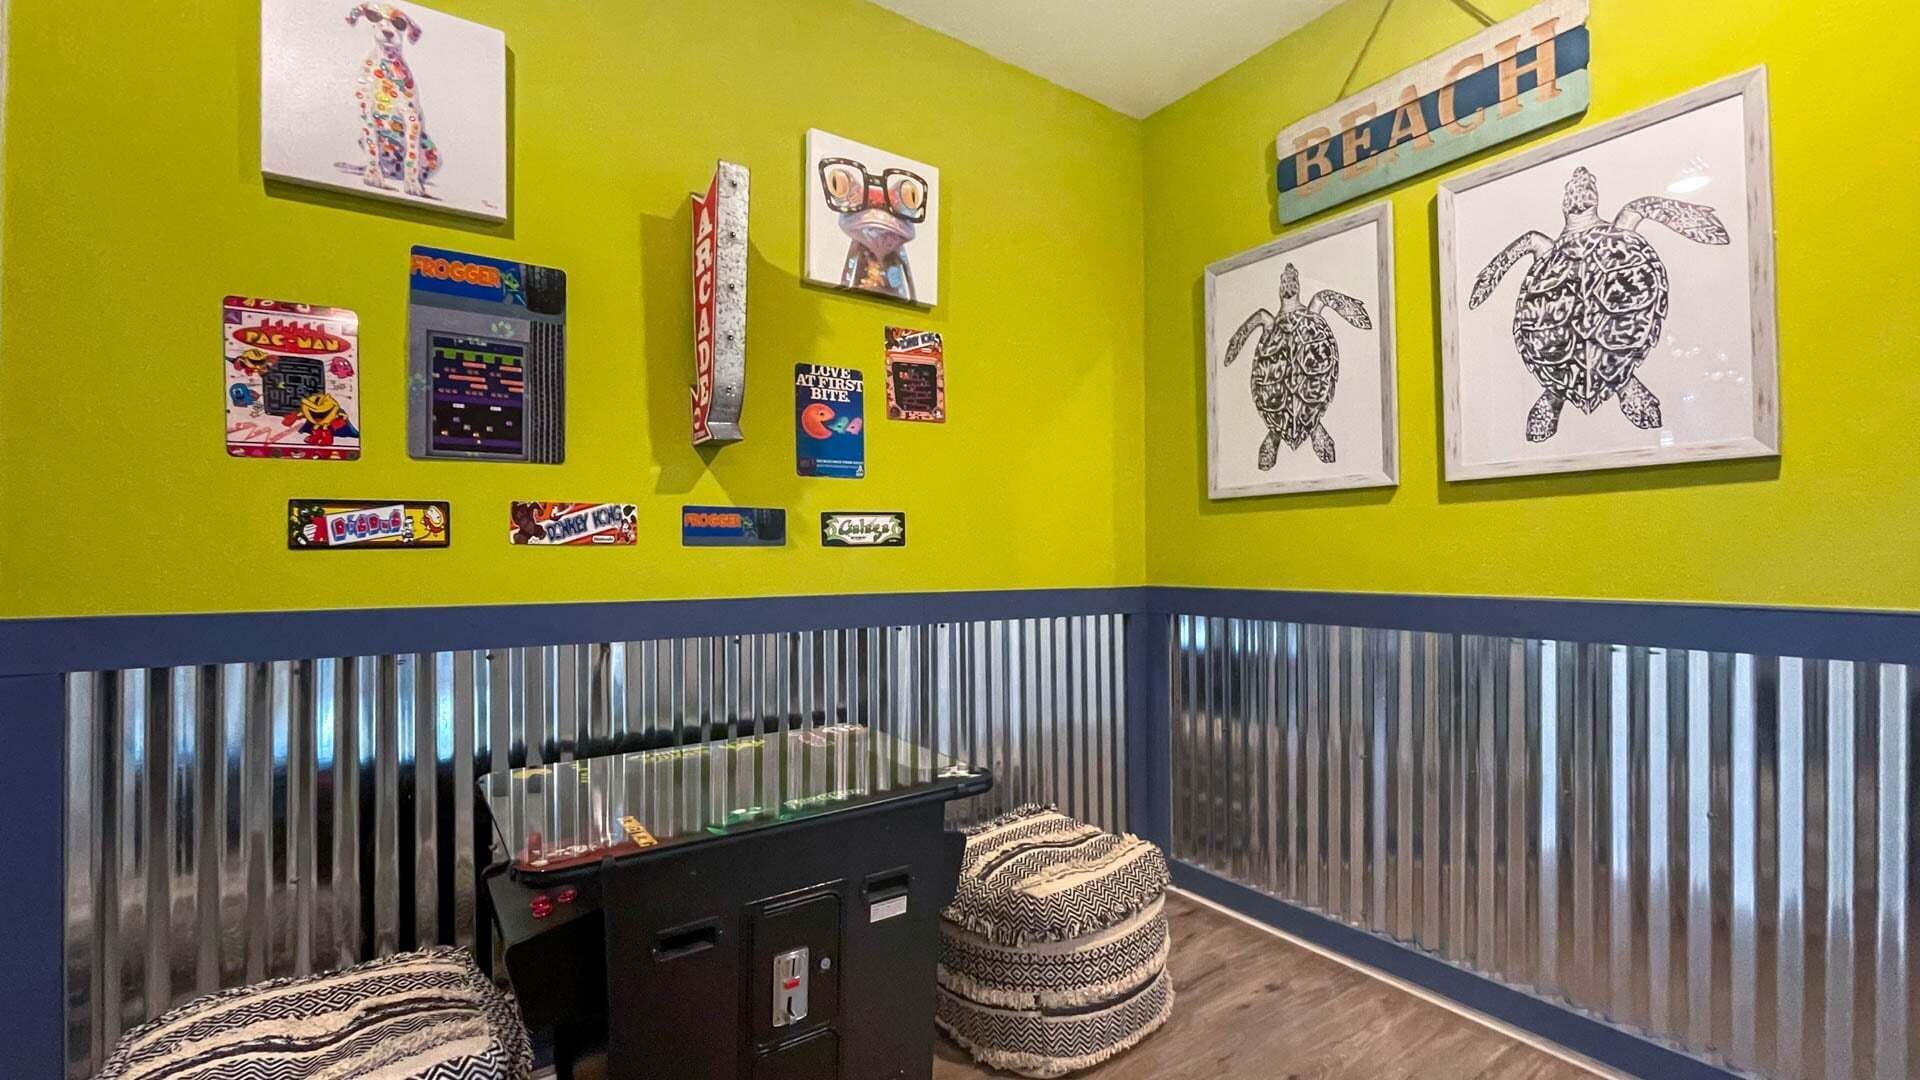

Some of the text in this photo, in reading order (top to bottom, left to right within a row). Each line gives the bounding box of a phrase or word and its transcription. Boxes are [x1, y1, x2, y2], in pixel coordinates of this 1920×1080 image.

[1293, 16, 1562, 197] BEACH
[411, 254, 501, 288] FROGGER
[696, 207, 713, 407] ARCADE
[245, 330, 340, 351] PAC-MAN
[796, 373, 864, 393] AT FIRST
[811, 364, 851, 379] LOVE
[545, 505, 622, 542] DONKEY KONG
